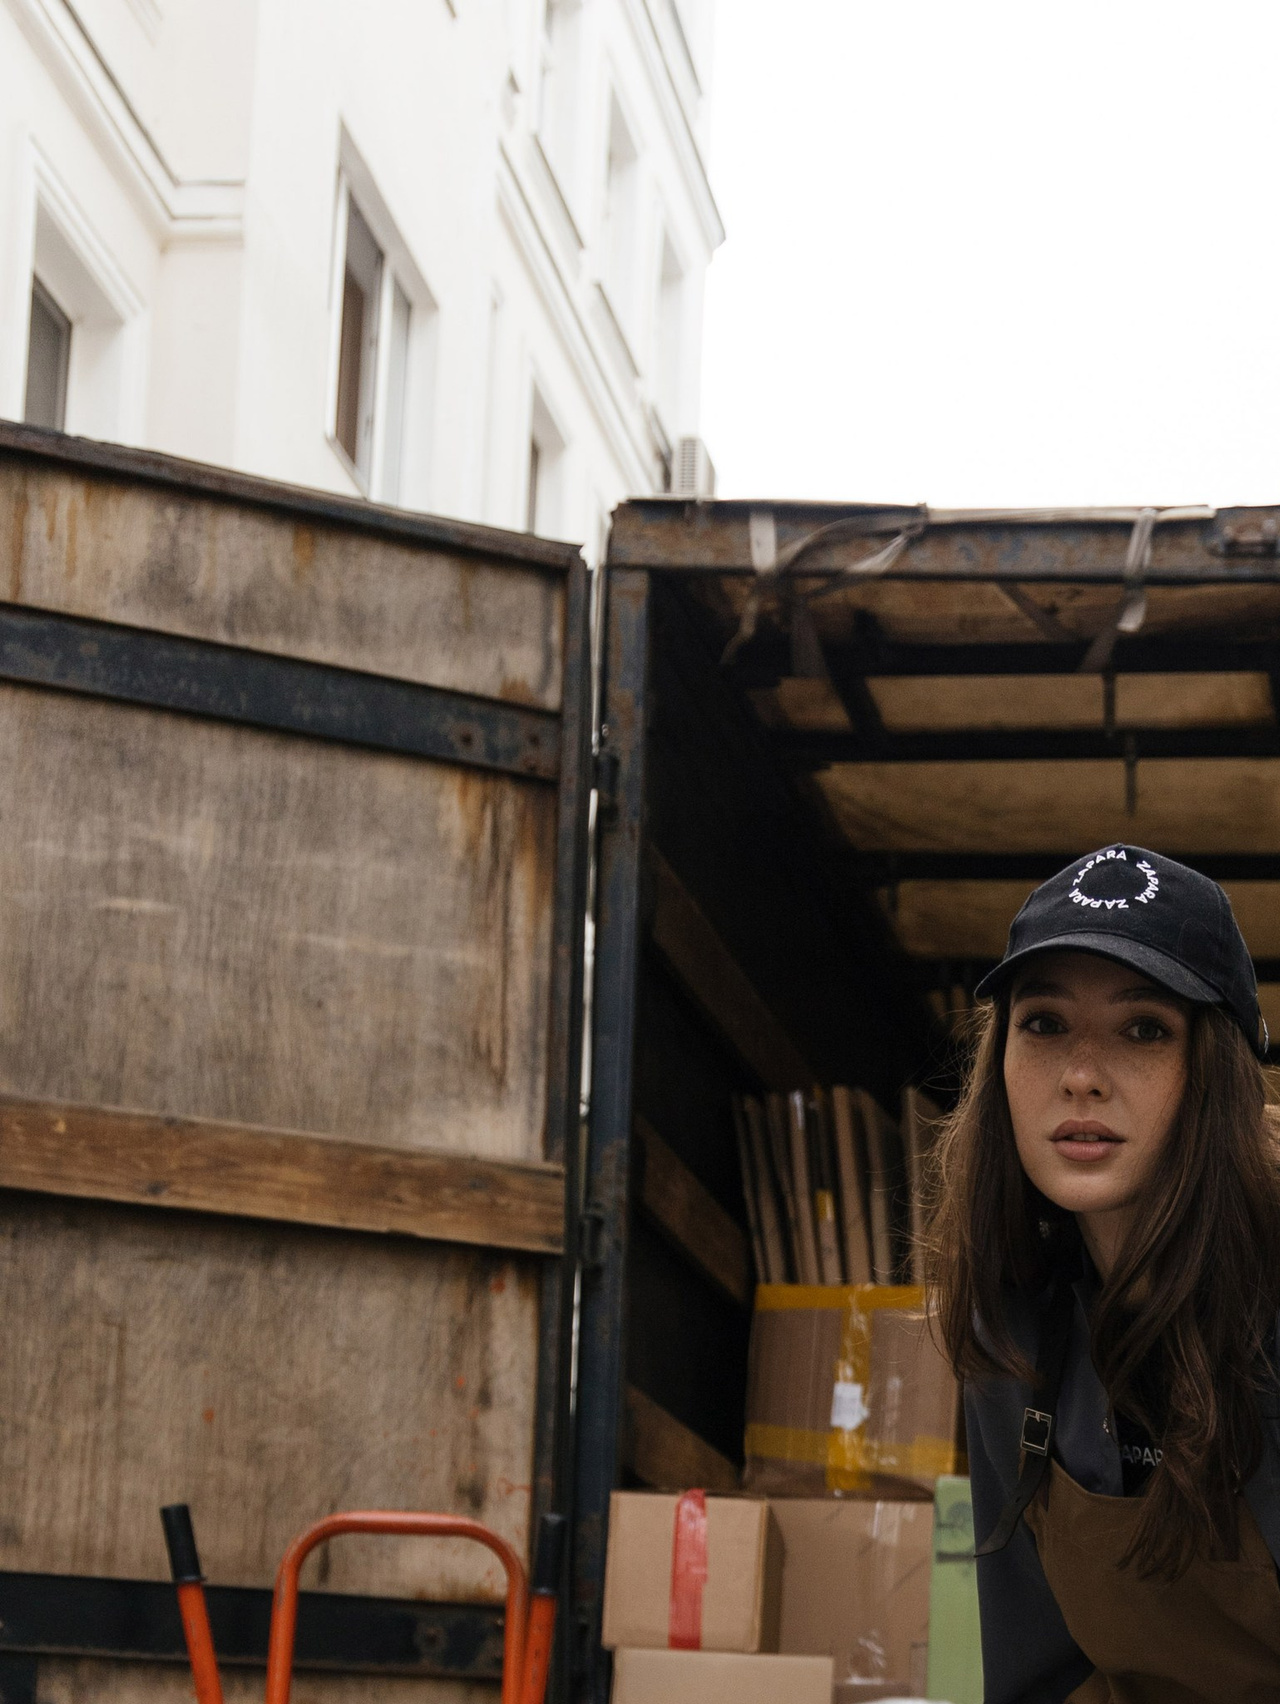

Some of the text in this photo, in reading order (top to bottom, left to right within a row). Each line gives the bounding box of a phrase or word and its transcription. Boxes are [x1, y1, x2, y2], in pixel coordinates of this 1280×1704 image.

[1068, 850, 1160, 910] ZAPARA ZAPARA ZAPARA
